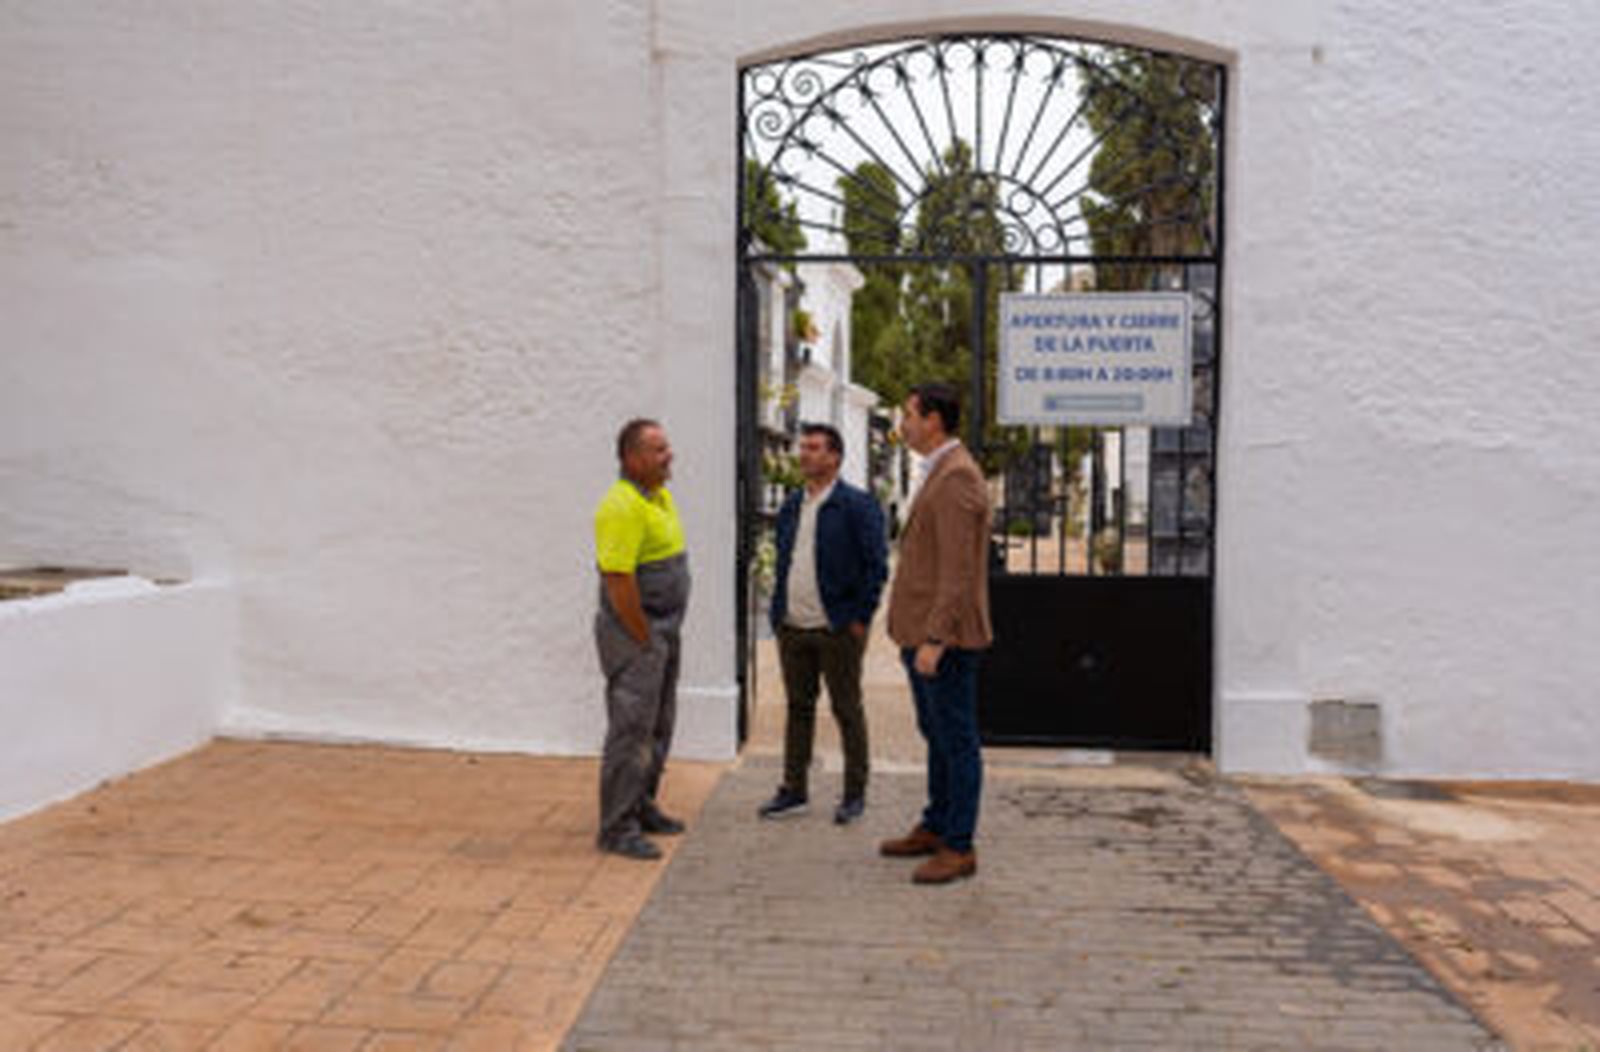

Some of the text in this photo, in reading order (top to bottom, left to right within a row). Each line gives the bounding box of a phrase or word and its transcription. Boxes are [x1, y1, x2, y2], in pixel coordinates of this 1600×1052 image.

[1011, 314, 1180, 327] APERTURA Y CIERRE
[1034, 337, 1155, 352] DE LA PUERTA
[1015, 367, 1037, 381] DE
[1096, 367, 1109, 381] A
